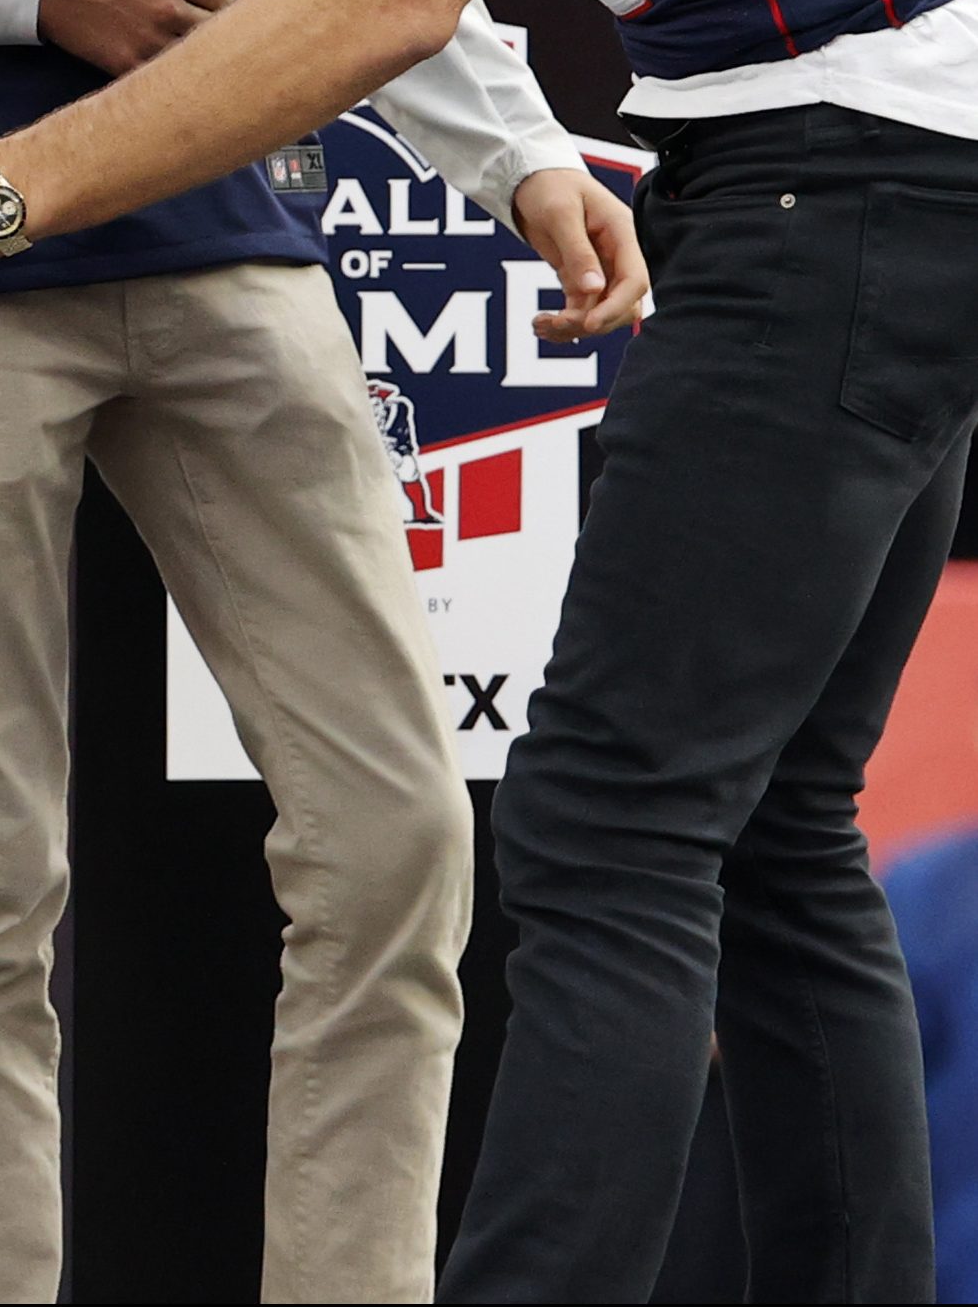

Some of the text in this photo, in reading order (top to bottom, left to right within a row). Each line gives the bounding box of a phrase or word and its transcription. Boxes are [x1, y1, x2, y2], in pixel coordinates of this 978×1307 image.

[340, 249, 393, 278] OF
[428, 598, 452, 613] BY
[443, 674, 510, 730] X
